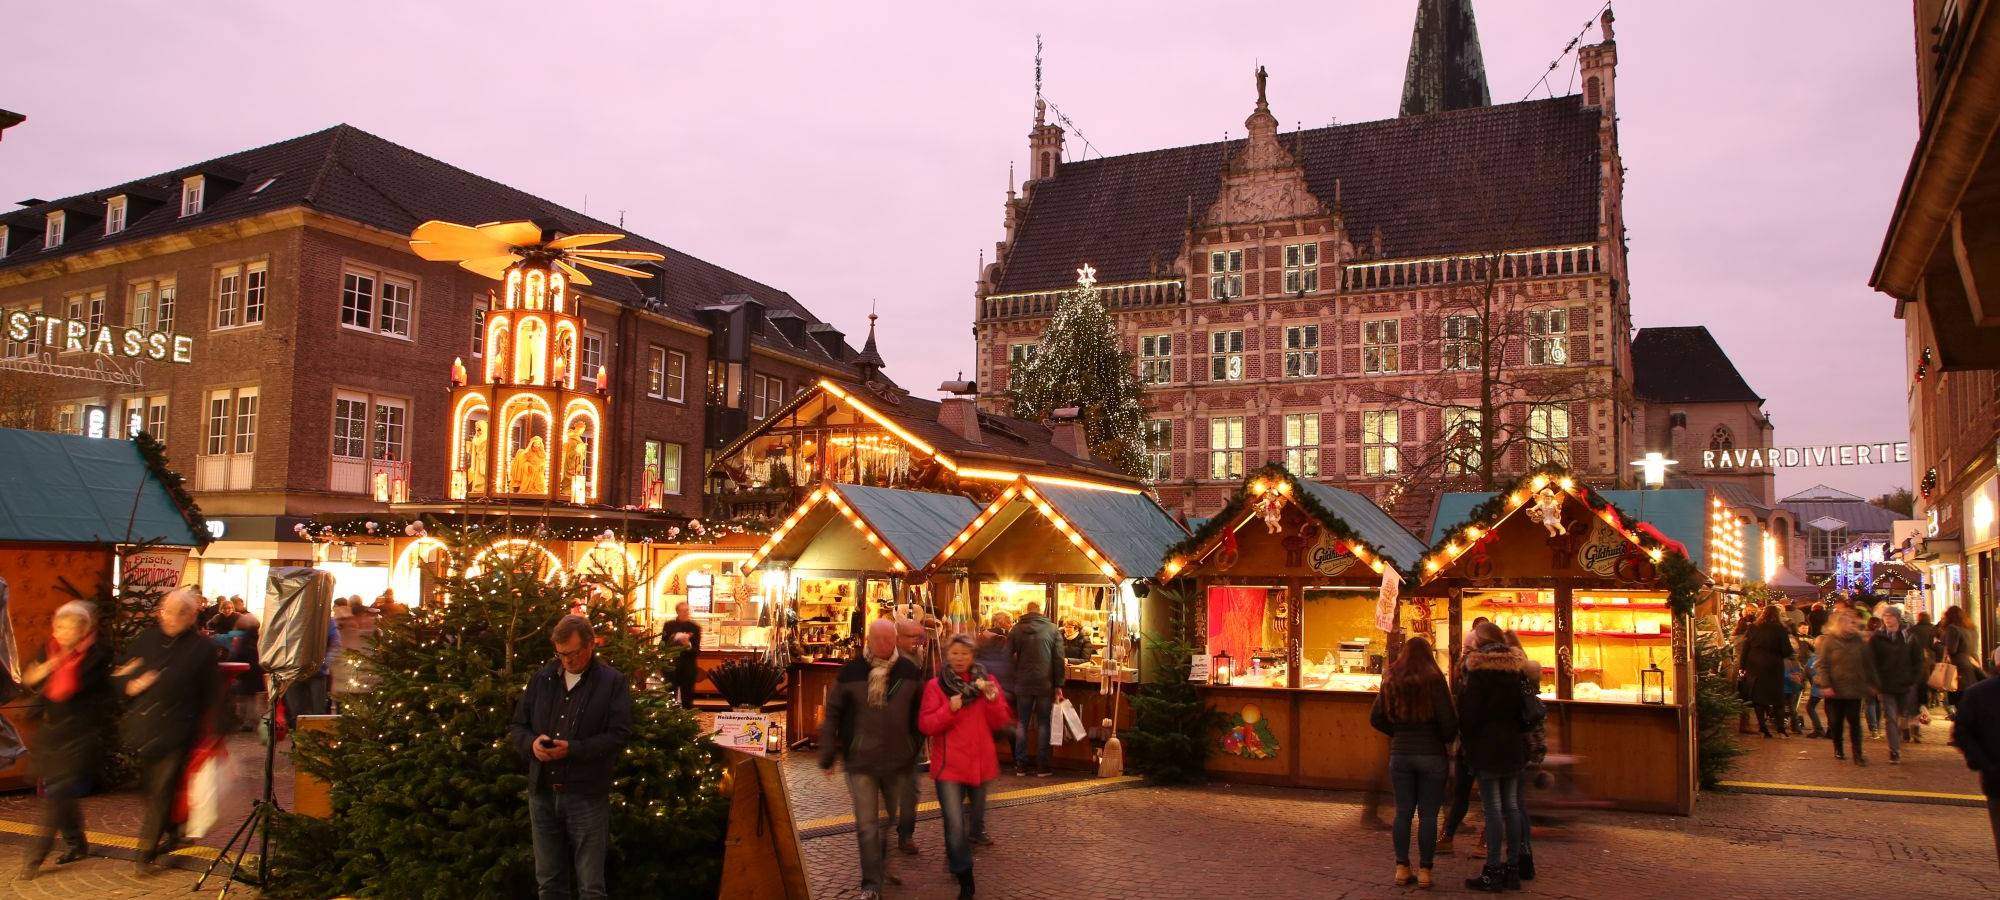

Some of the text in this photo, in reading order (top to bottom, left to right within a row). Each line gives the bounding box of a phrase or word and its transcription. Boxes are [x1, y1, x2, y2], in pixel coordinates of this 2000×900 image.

[0, 310, 192, 363] STRASSE
[1551, 338, 1566, 362] 6
[1229, 355, 1241, 378] 3
[134, 555, 173, 566] Frische
